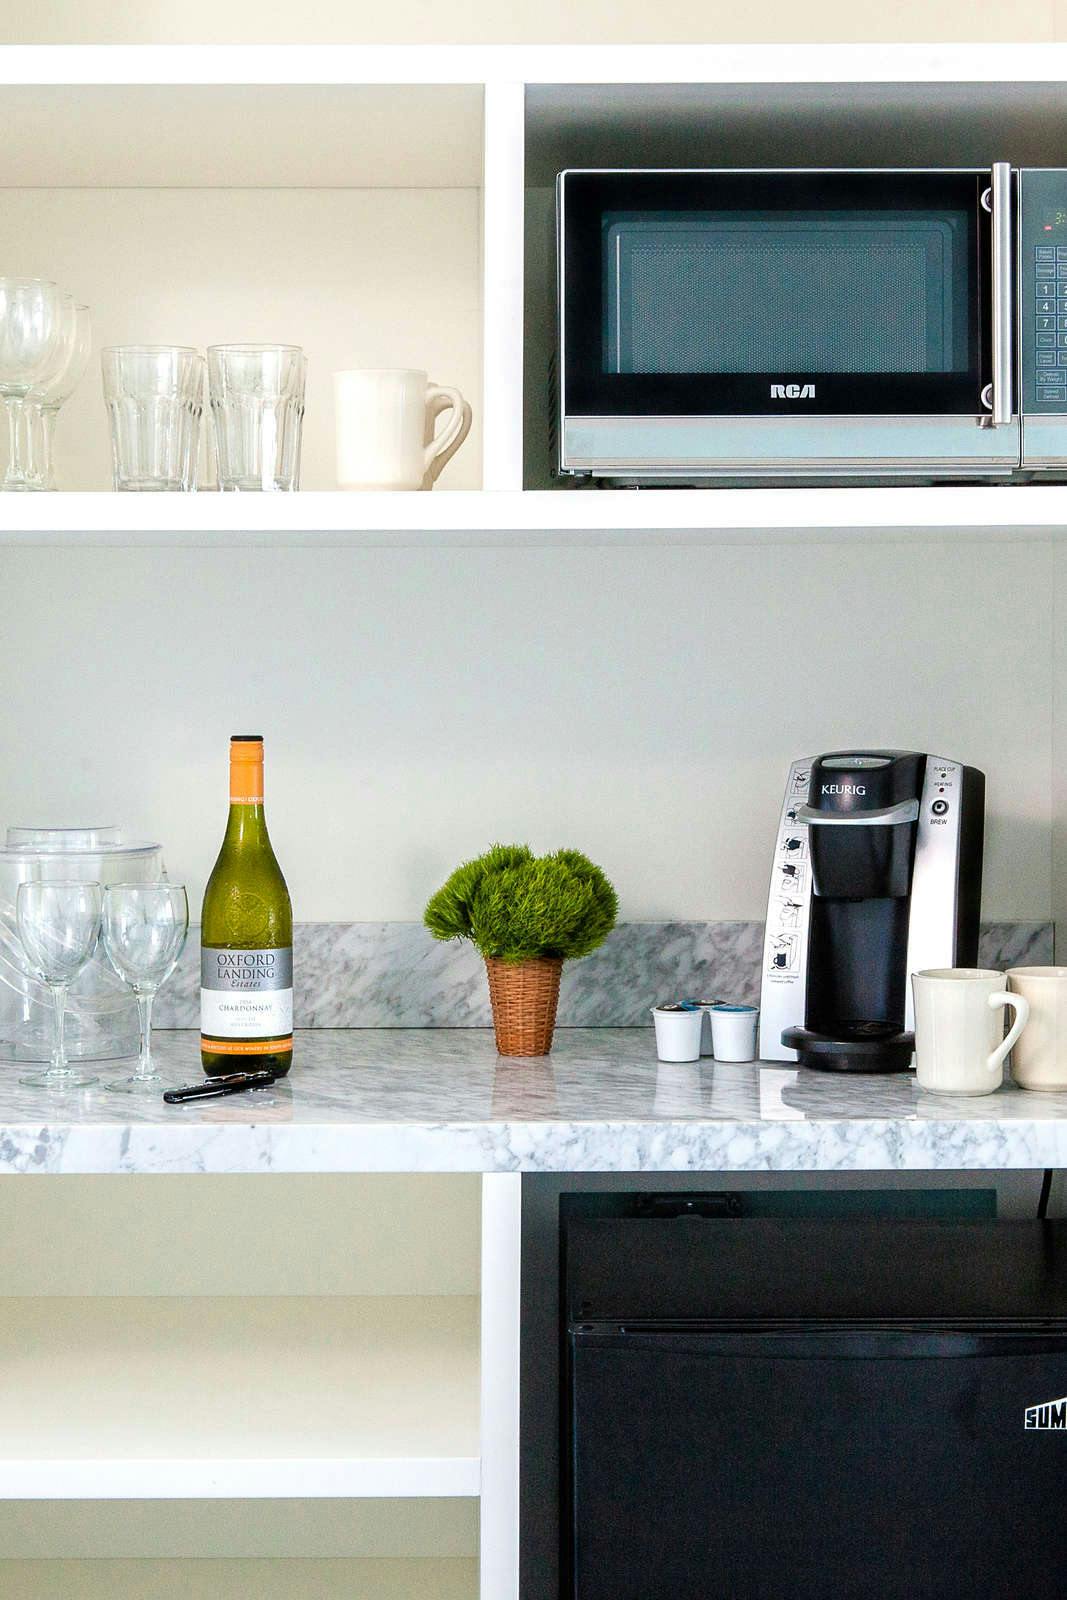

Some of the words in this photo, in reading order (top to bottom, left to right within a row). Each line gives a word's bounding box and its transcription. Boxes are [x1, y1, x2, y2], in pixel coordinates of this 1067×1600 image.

[1042, 285, 1048, 294] 1
[1042, 302, 1049, 311] 4
[1043, 319, 1049, 328] 7
[770, 384, 816, 399] RCA
[821, 784, 866, 796] KEURIG
[217, 953, 275, 966] OXFORD
[217, 967, 275, 979] LANDING
[218, 1004, 273, 1012] CHARDONNAY
